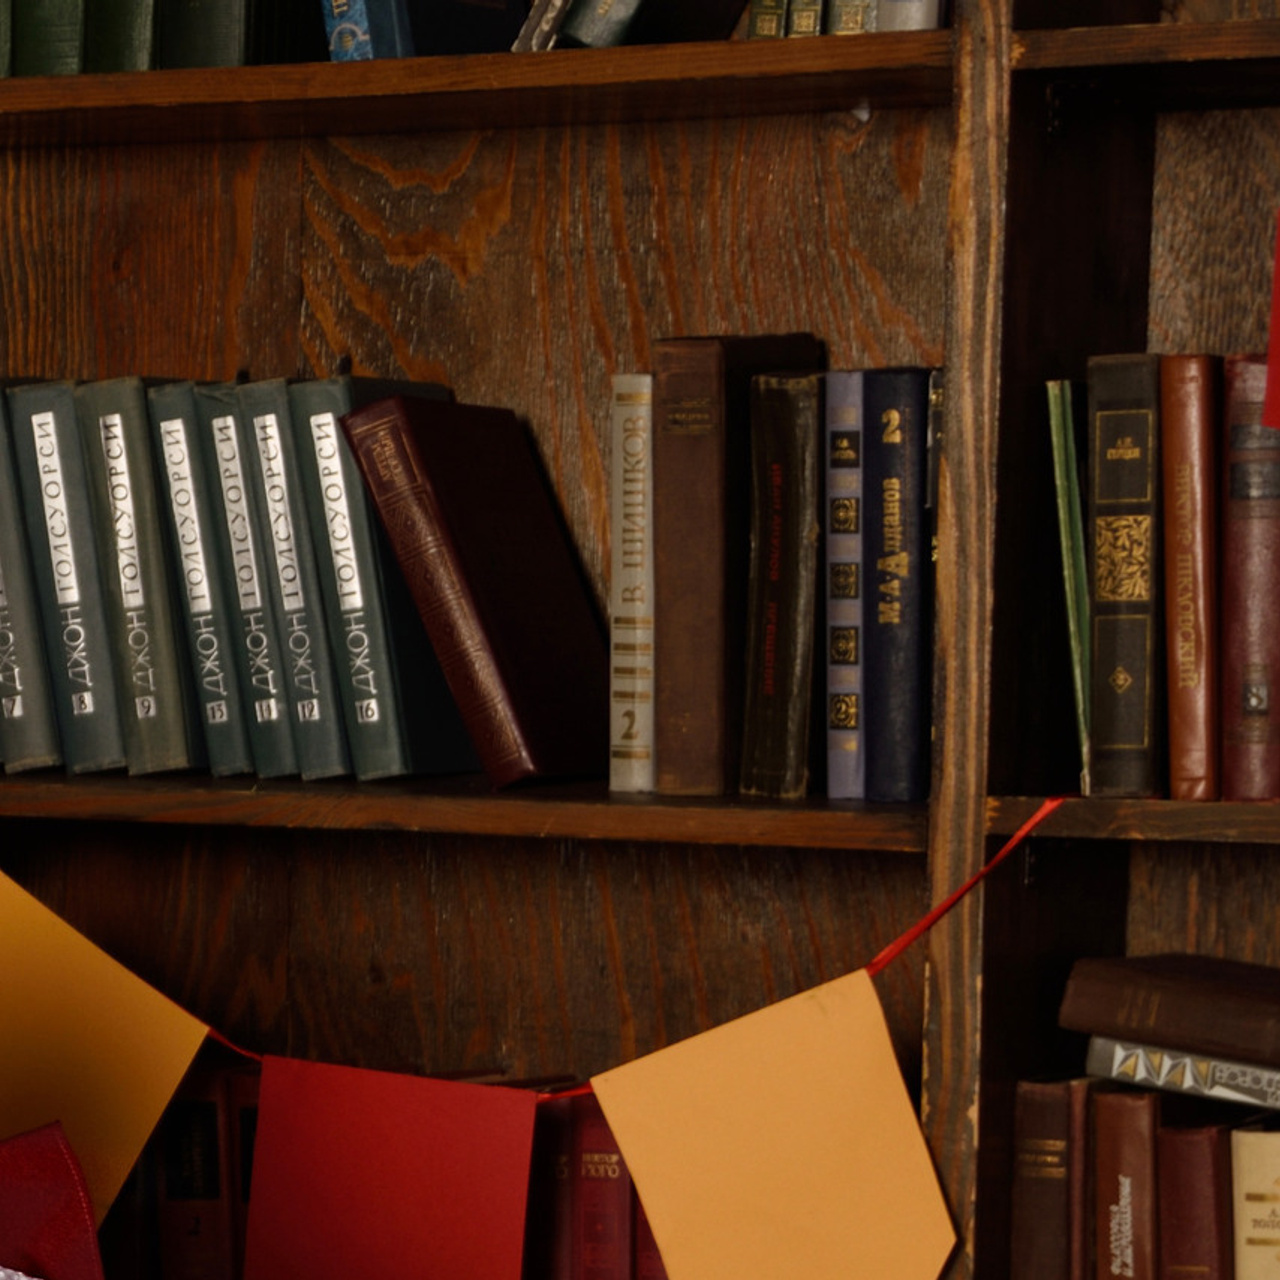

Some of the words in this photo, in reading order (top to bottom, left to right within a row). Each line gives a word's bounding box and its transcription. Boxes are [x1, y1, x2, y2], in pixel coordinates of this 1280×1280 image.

[881, 408, 902, 443] 2
[36, 420, 74, 591] ГОЛСУОРСИ
[103, 422, 140, 595] ГОЛСУОРСИ
[165, 428, 206, 600] ГОЛСУОРСИ
[216, 425, 256, 598] ГОЛСУОРСИ
[258, 423, 299, 598] ГОЛСУОРСИ
[315, 421, 357, 598] ГОЛСУОРСИ
[622, 416, 646, 570] ШИШКОВ
[1175, 464, 1192, 547] ВИКТОР
[60, 606, 93, 687] ДЖОН
[126, 610, 156, 691] ДЖОН
[193, 614, 228, 696] ДЖОН
[243, 612, 278, 694] ДЖОН
[287, 612, 320, 694] ДЖОН
[343, 611, 378, 694] ДЖОН
[1177, 554, 1199, 688] ШКЛОВСКИЙ
[7, 699, 17, 717] 7
[78, 695, 87, 710] 8
[141, 699, 151, 715] 9
[301, 701, 316, 718] 12
[359, 702, 375, 719] 16
[622, 710, 639, 741] 2
